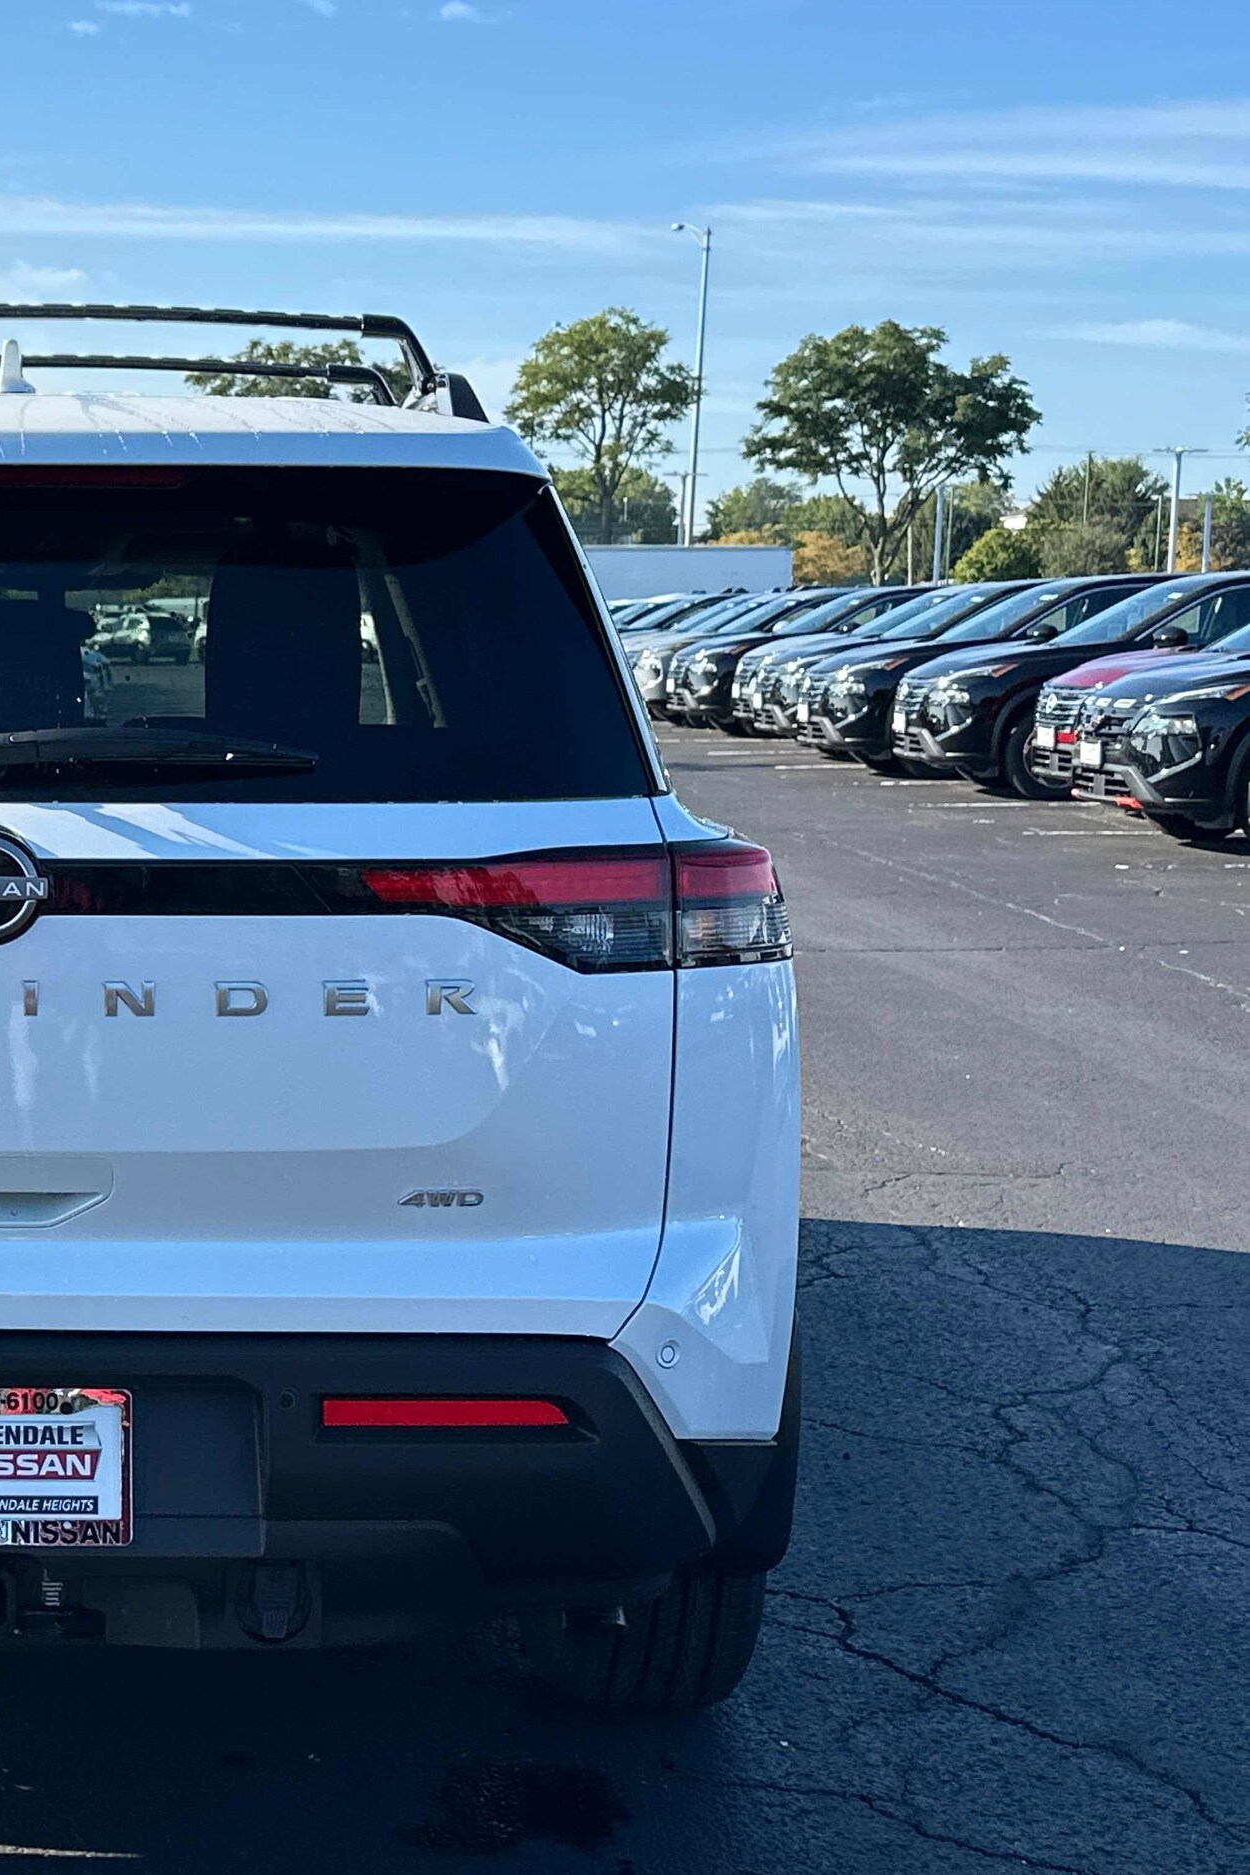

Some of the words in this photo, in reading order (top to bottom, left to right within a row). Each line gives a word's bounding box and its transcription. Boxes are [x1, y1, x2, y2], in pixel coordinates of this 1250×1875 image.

[397, 1189, 484, 1208] 4WD
[42, 1498, 95, 1512] HEIGHTS
[11, 1519, 122, 1544] NISSAN
